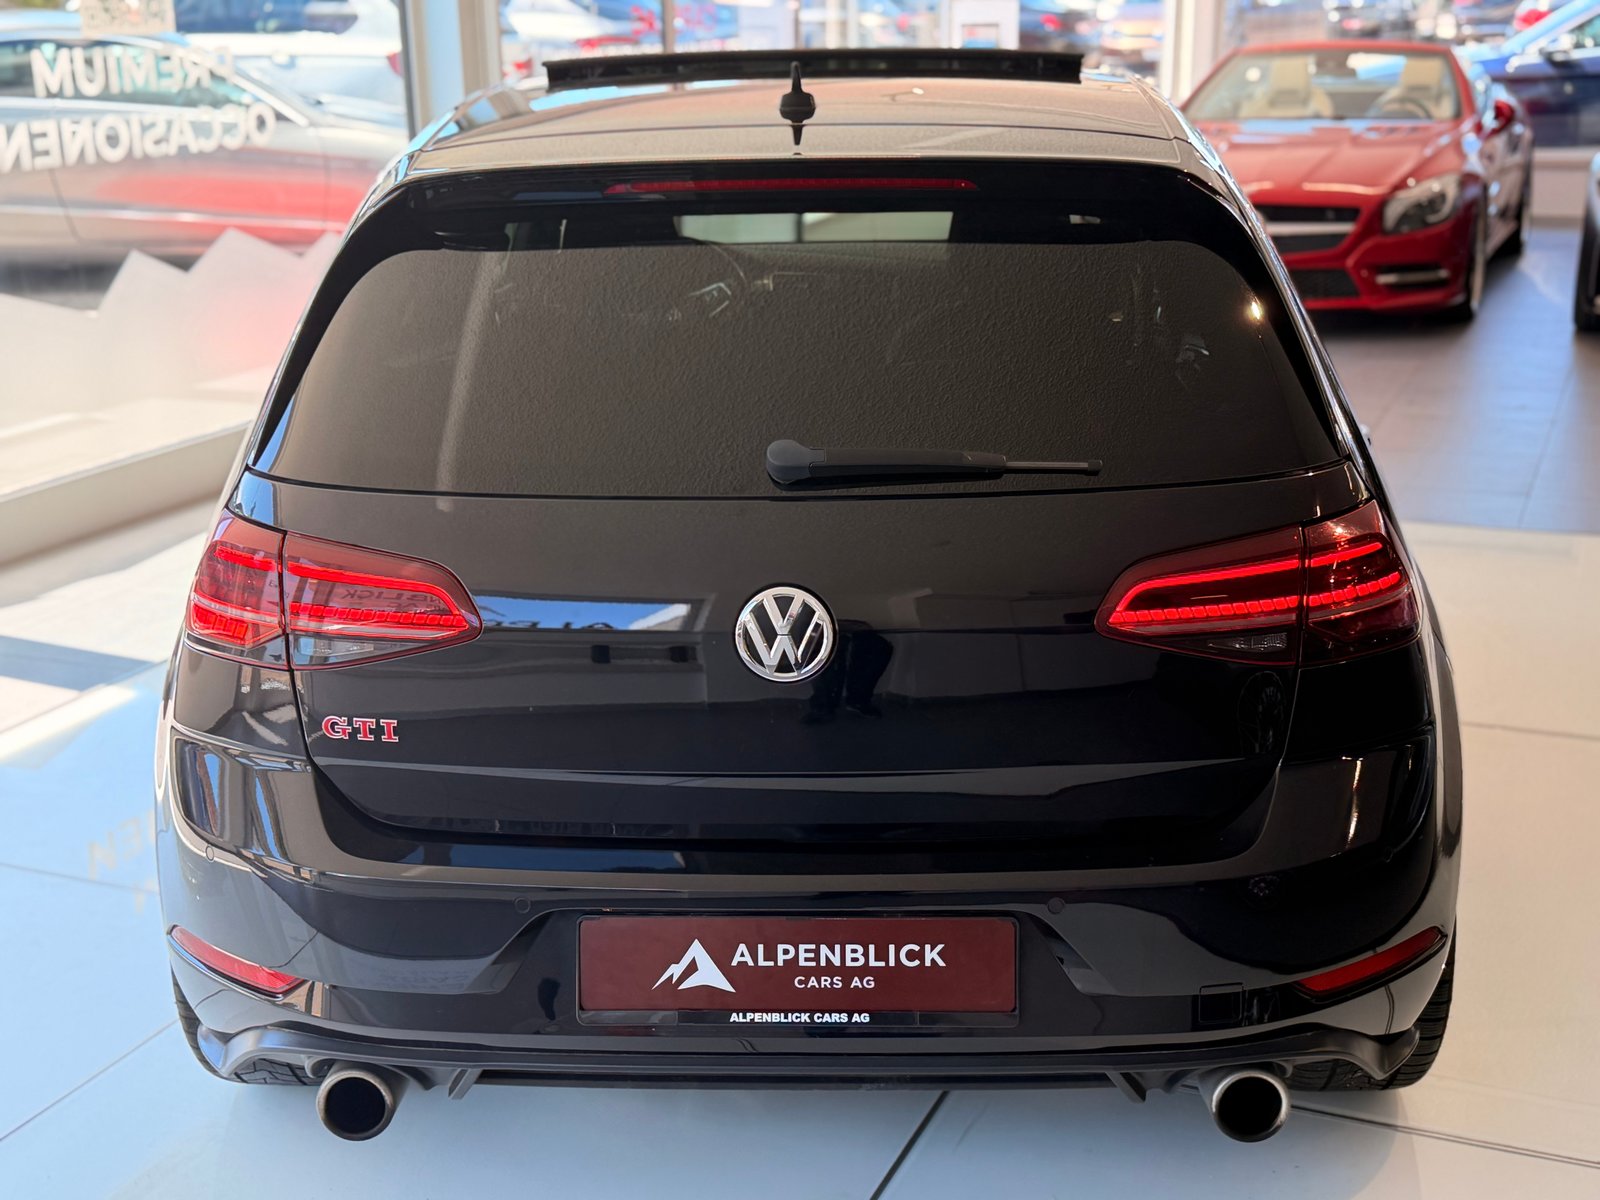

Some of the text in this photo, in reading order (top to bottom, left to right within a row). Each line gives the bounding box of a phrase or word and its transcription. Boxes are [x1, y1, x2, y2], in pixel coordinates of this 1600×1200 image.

[734, 586, 835, 683] VW
[321, 715, 399, 742] GTI
[730, 943, 947, 967] ALPENBLICK
[794, 976, 876, 989] CARS AG
[729, 1012, 871, 1023] ALPENBLICK CARS AG
